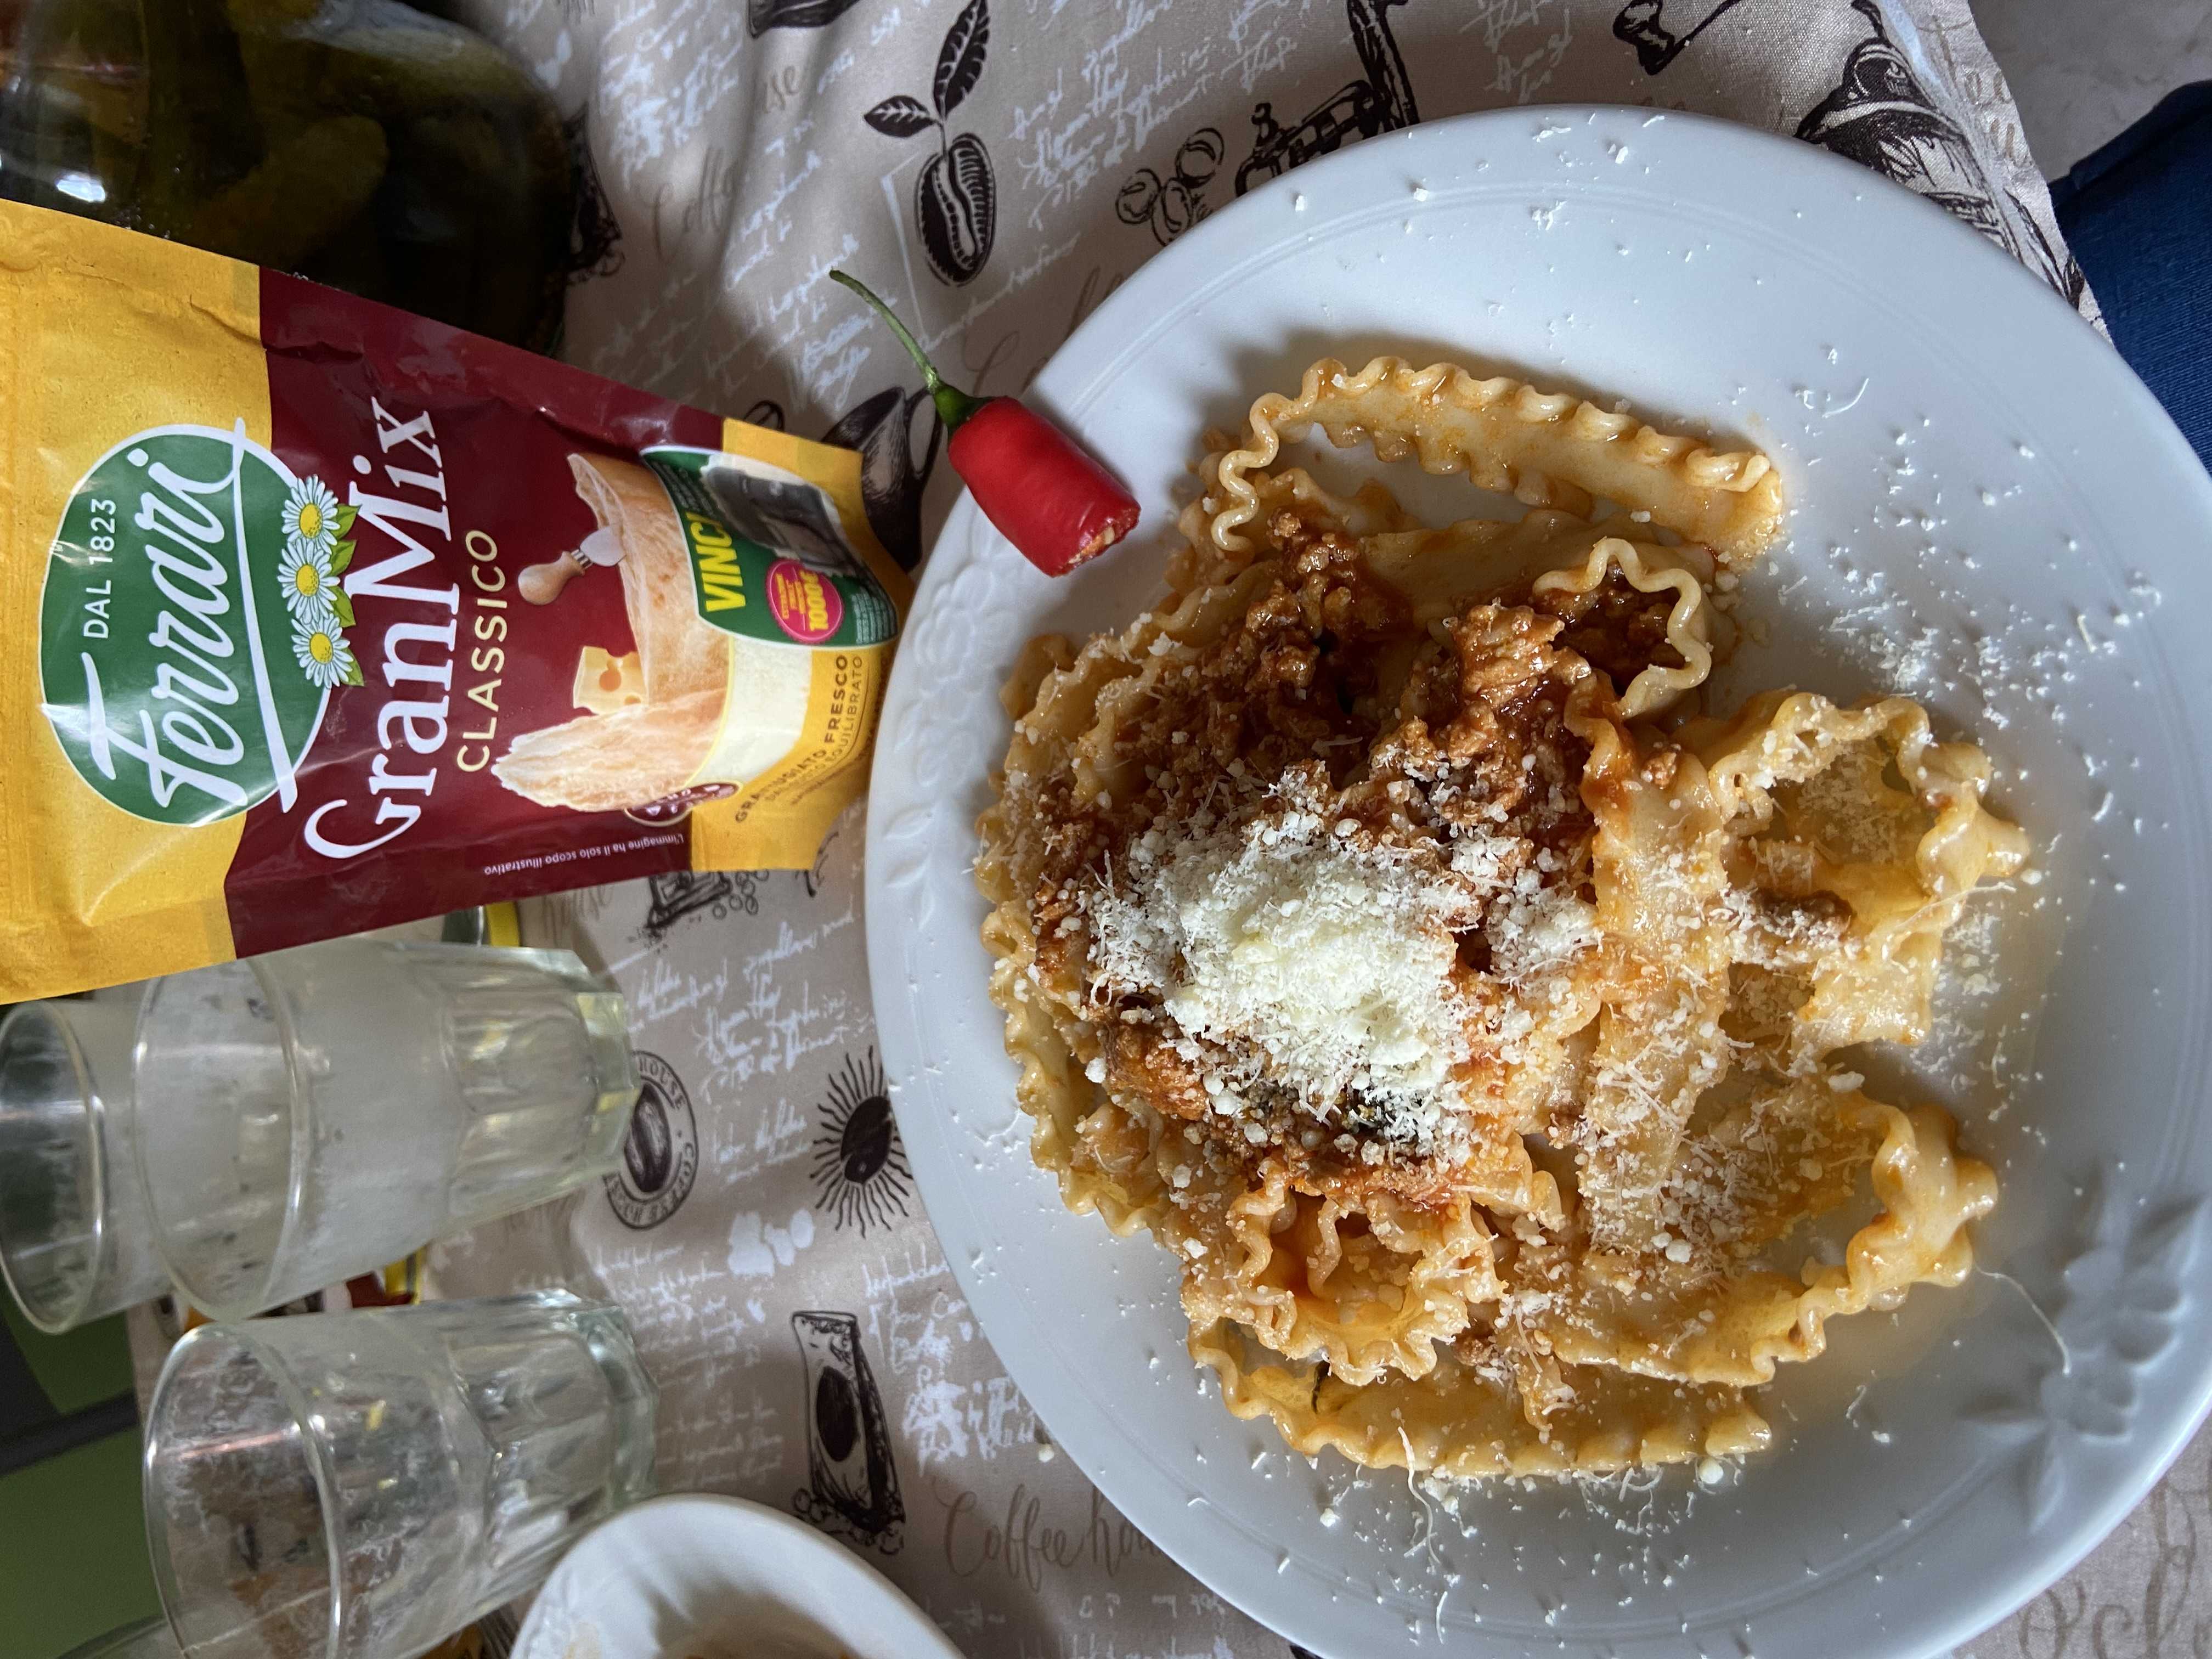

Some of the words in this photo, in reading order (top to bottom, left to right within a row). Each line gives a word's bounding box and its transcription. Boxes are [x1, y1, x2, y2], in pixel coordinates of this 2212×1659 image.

[89, 498, 116, 566] 1823
[685, 511, 746, 612] VINCI
[80, 447, 249, 808] Ferrari
[83, 579, 112, 639] DAL
[456, 529, 508, 772] CLASSICO
[824, 655, 848, 743] FRESCO
[484, 859, 543, 876] illustrativo
[545, 853, 577, 865] scopo
[579, 848, 602, 859] solo
[605, 845, 611, 856] il
[613, 843, 627, 853] ha
[629, 833, 684, 849] L'immagine
[934, 1483, 1084, 1594] Coffee
